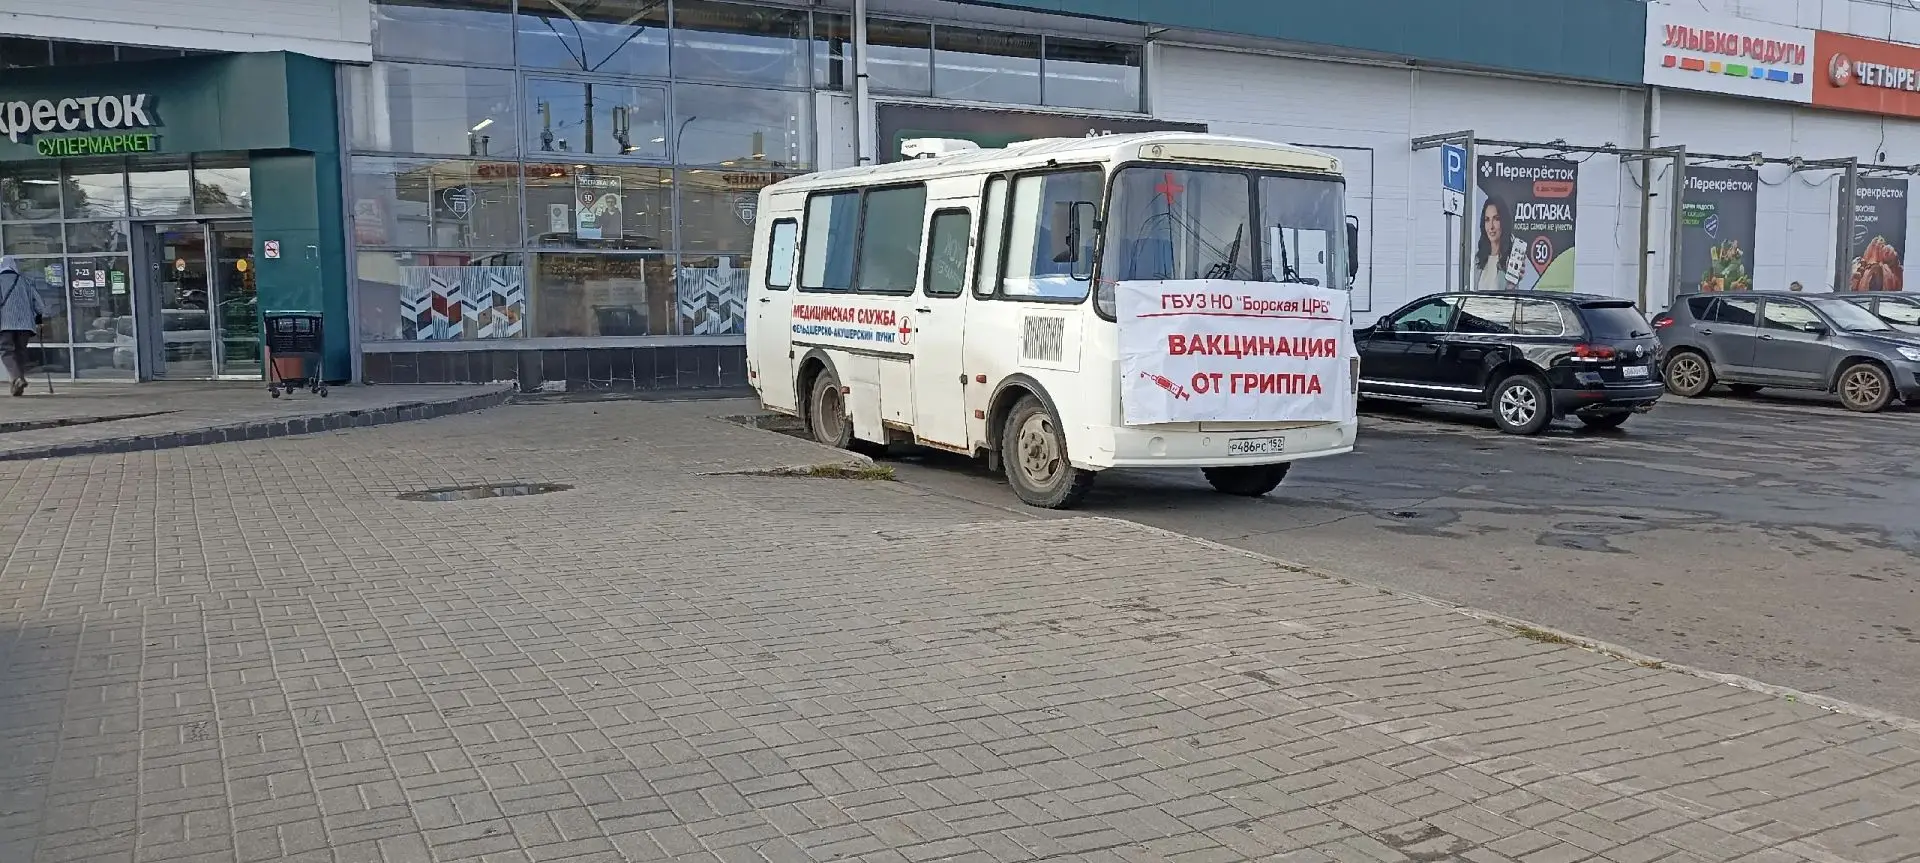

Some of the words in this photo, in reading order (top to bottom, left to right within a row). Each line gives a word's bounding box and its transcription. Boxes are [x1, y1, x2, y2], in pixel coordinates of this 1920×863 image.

[1855, 61, 1915, 90] ЧЕТЫРЕ
[36, 133, 153, 156] СУПЕРМАРКЕТ
[1495, 162, 1574, 181] Перекрёсток
[1690, 176, 1753, 192] Перекрёсток
[1856, 186, 1904, 200] ерекрёсток
[1536, 244, 1548, 259] 30
[1161, 294, 1207, 310] ГБУЗ
[1211, 295, 1233, 310] НО
[1236, 296, 1299, 314] "Борская
[1302, 298, 1331, 314] ЦРБ"
[792, 304, 855, 323] МЕДИЦИНСКАЯ
[857, 308, 896, 326] СЛУЖБА
[875, 331, 896, 343] ПУНКТ
[1168, 334, 1337, 360] ВАКЦИНАЦИЯ
[1191, 372, 1223, 394] ОТ
[1230, 373, 1322, 395] ГРИППА
